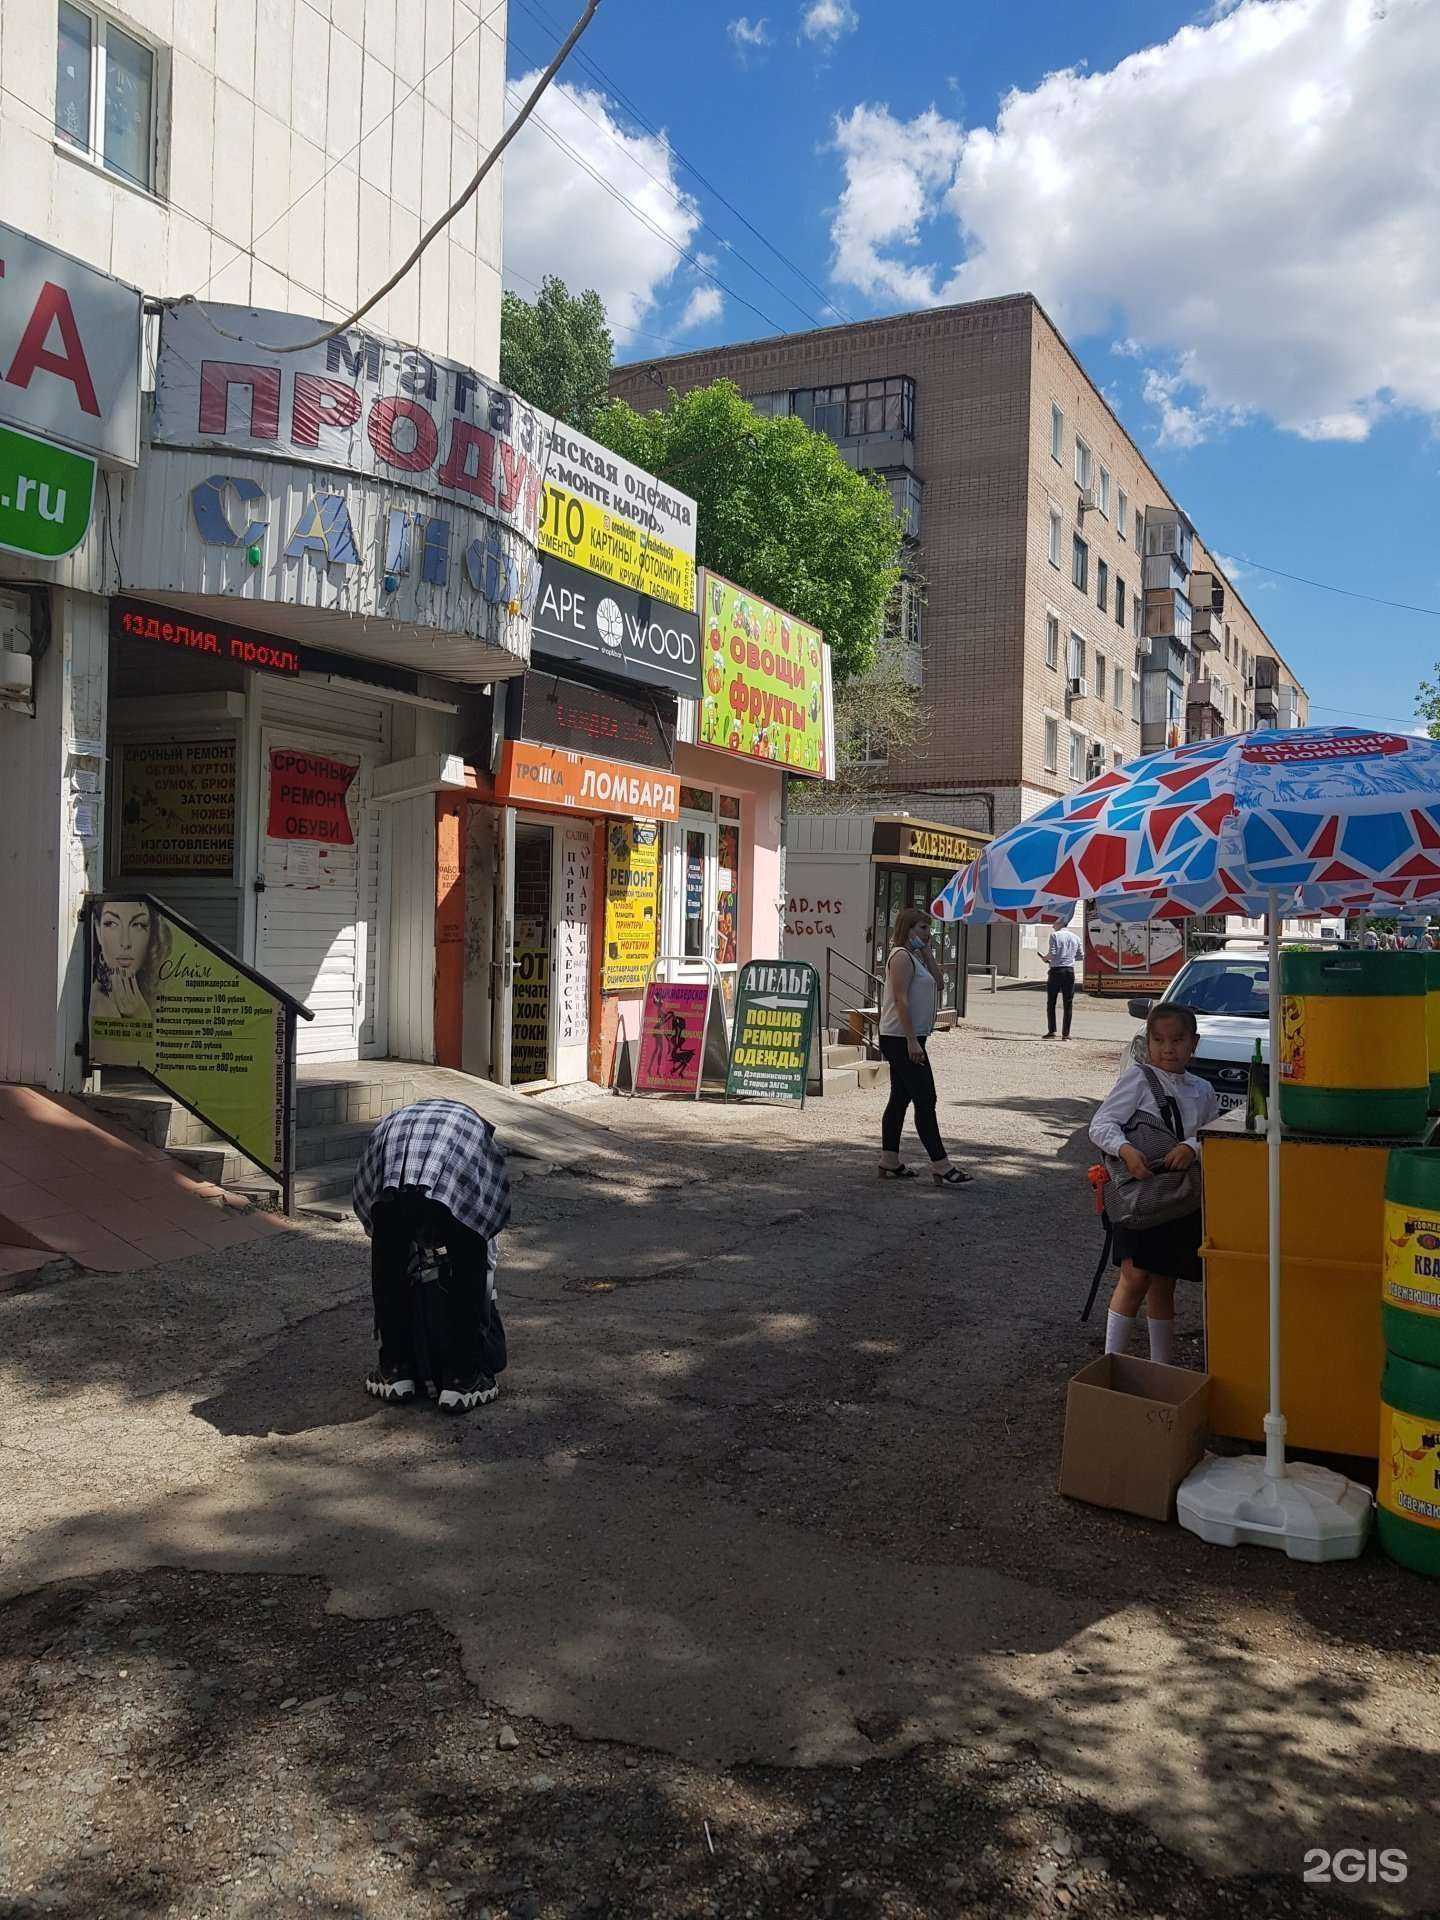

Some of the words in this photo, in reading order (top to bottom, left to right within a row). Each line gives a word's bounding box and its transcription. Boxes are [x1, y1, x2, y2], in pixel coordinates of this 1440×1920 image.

[0, 259, 101, 418] А
[590, 527, 632, 565] КАРТИНЫ
[540, 584, 586, 630] APE
[625, 613, 696, 665] WOOD
[231, 639, 299, 671] прохл
[730, 635, 805, 690] ОВОЩИ
[185, 745, 236, 760] РЕМОНТ
[1243, 734, 1394, 754] НАСТОЯЩИЙ
[1263, 745, 1382, 761] ПЛОМБИР
[181, 793, 236, 805] ЗАТОЧКА
[580, 769, 675, 813] ЛОМБАРД
[285, 816, 340, 839] ОБУВИ
[140, 838, 235, 851] ИЗГОТОВЛЕНИЕ
[610, 868, 655, 888] РЕМОНТ
[783, 920, 836, 938] абота
[744, 966, 813, 995] АТЕЛЬЕ
[746, 1008, 803, 1028] ПОШИВ
[742, 1028, 802, 1048] РЕМОНТ
[734, 1048, 804, 1069] ОДЕЖДЫ
